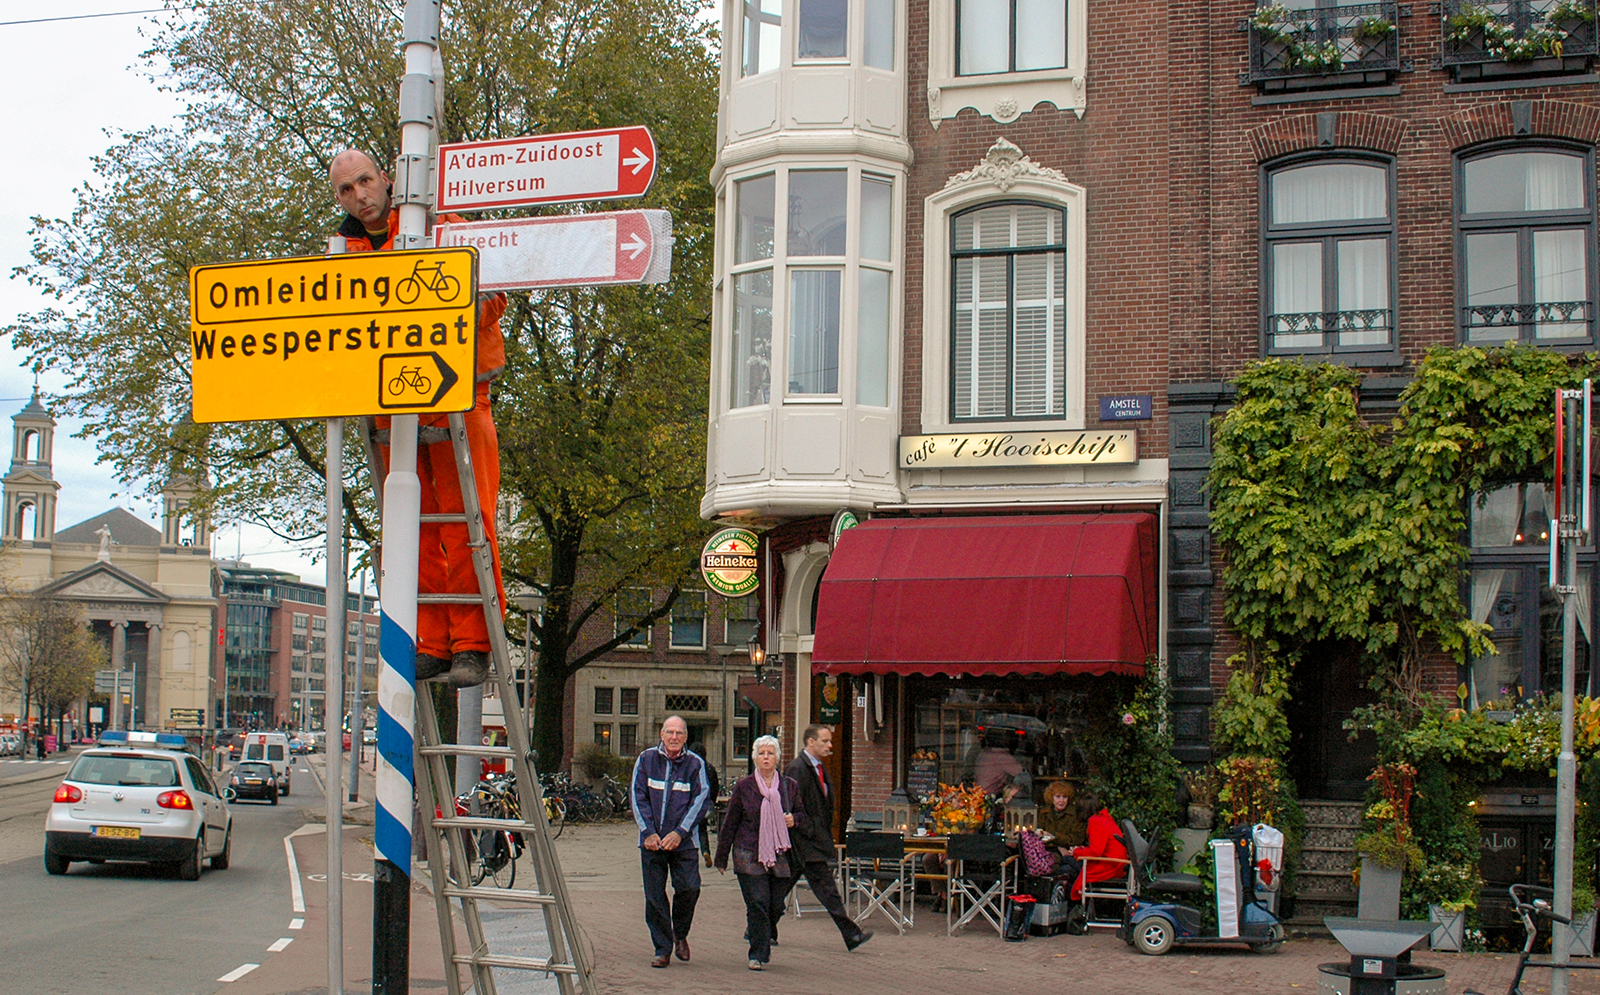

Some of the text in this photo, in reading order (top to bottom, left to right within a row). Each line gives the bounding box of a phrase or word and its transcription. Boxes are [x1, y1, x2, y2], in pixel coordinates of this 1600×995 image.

[448, 141, 603, 171] A'dam-Zuidoost
[448, 175, 545, 198] Hilversum
[209, 272, 390, 309] Omleiding
[192, 314, 468, 362] Weesperstraat
[1109, 399, 1140, 409] AMSTEL
[100, 827, 136, 837] 81-SZ-BG
